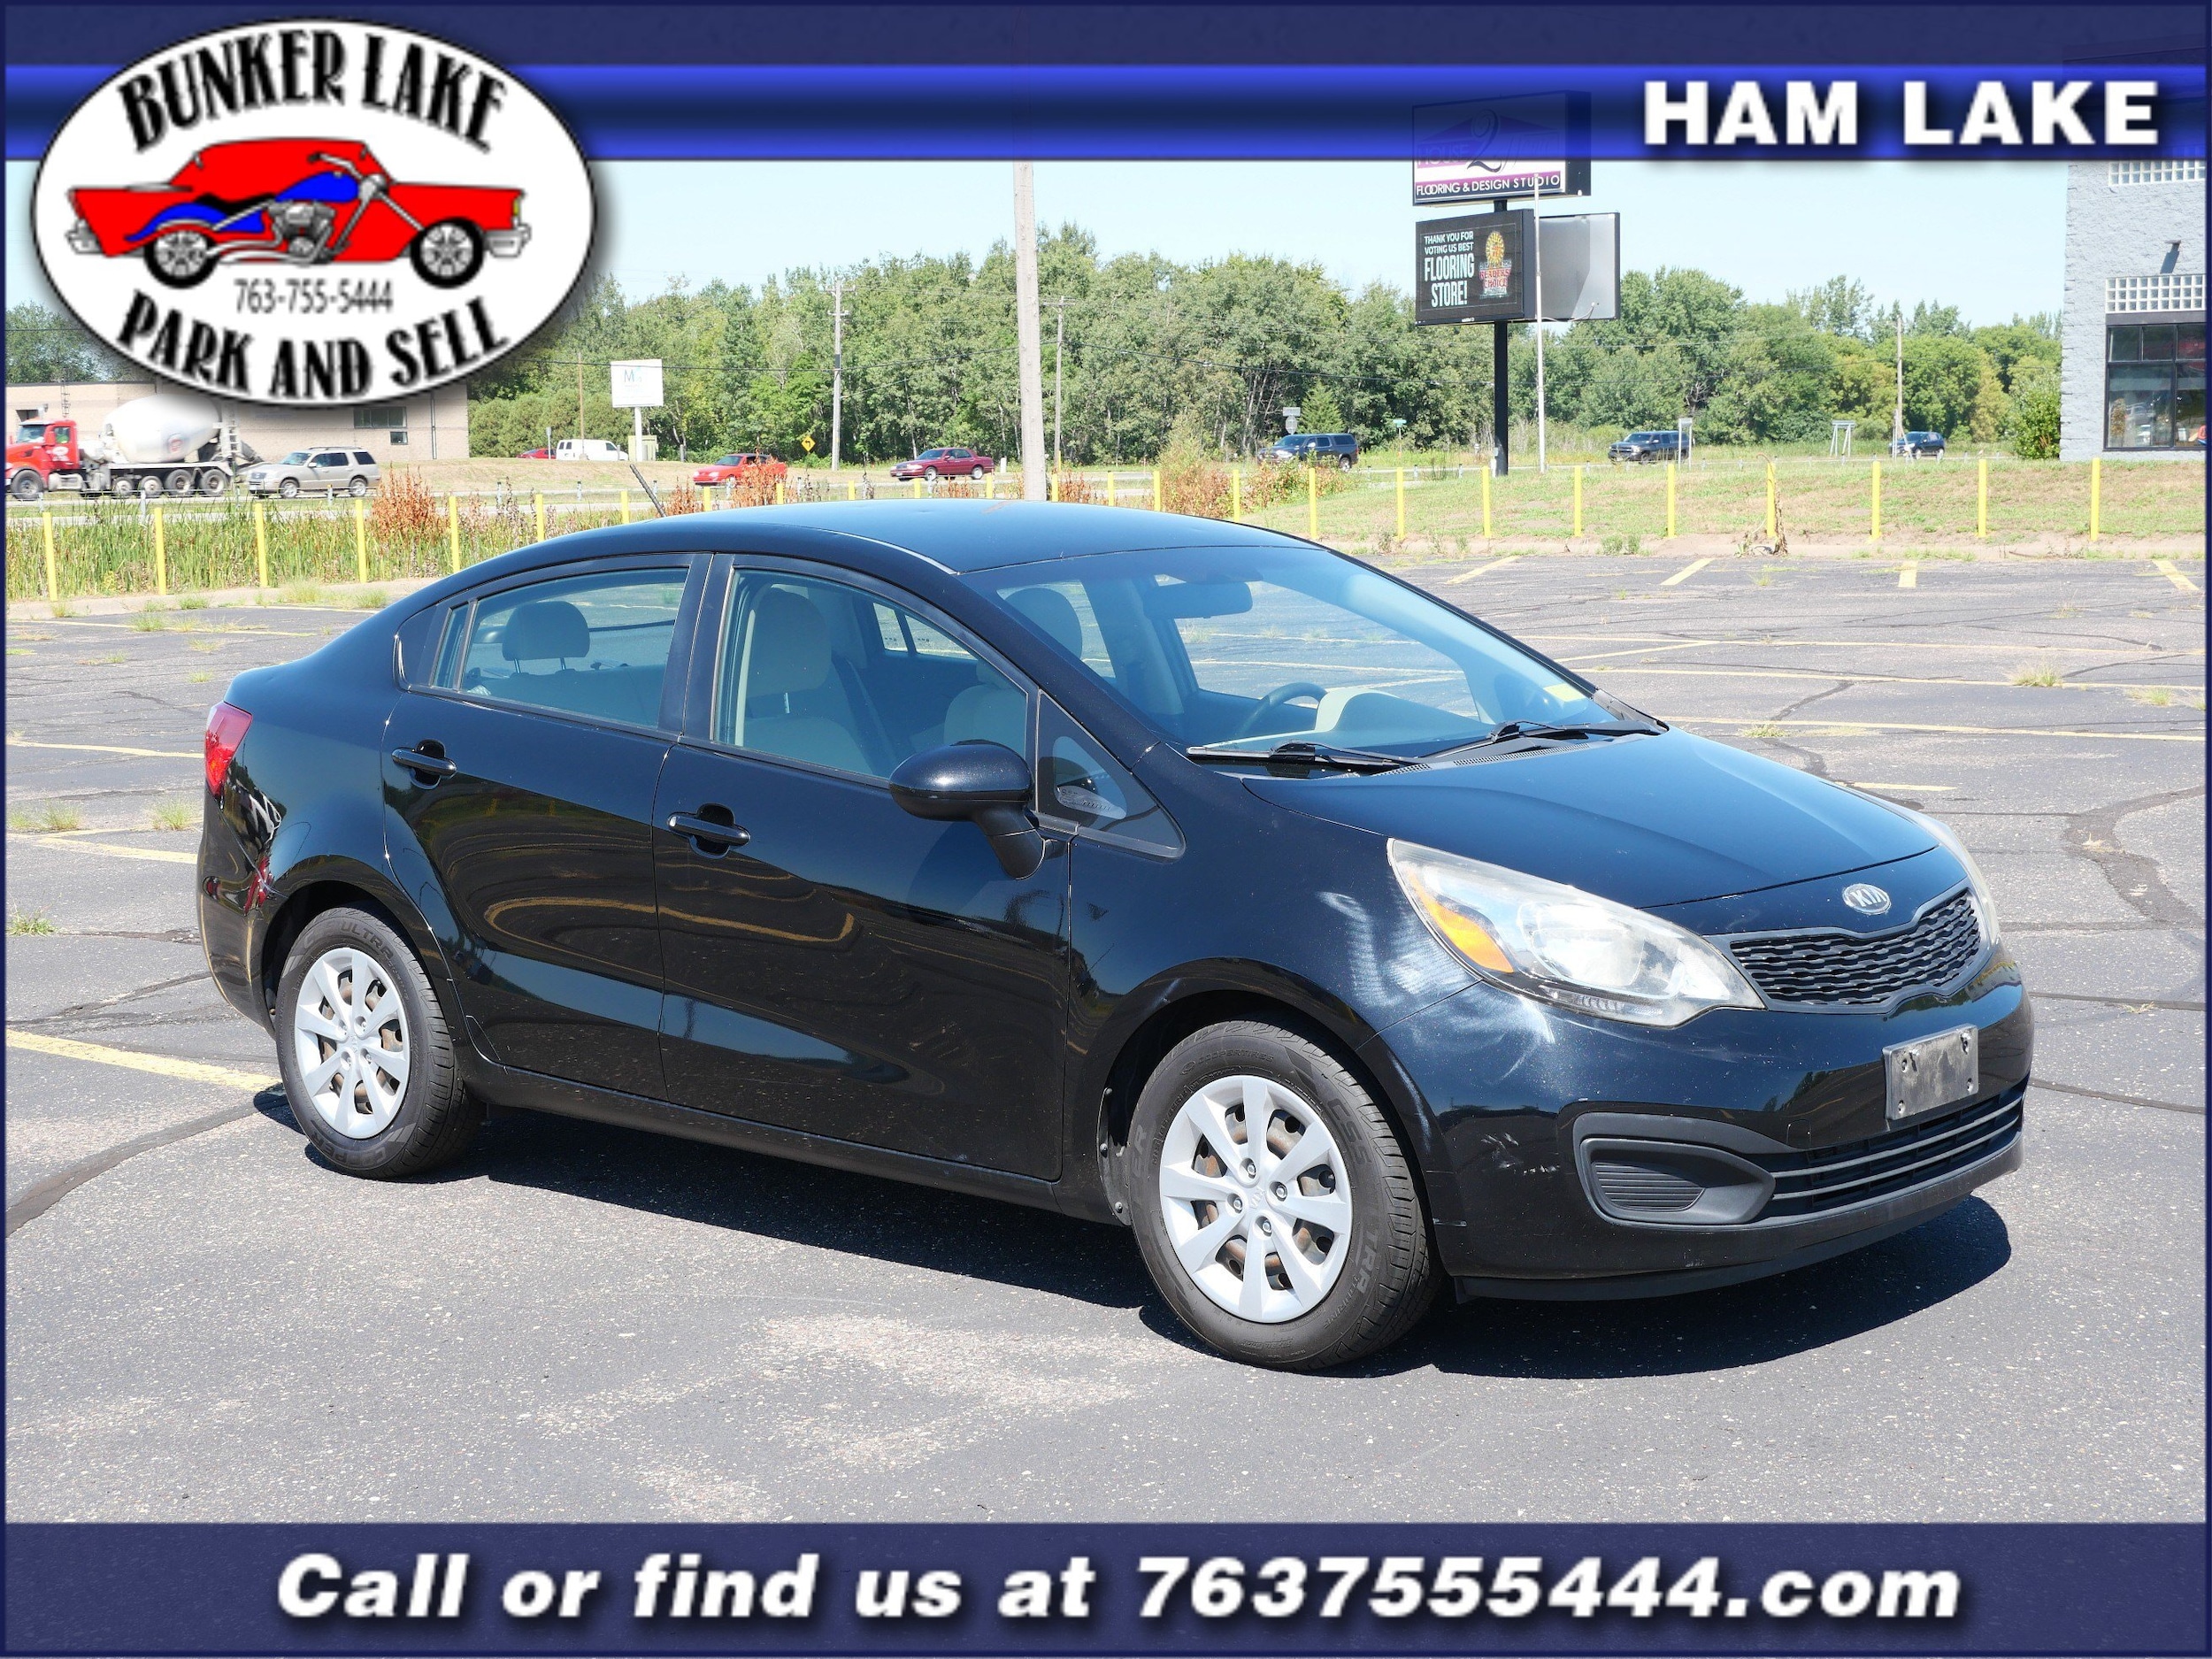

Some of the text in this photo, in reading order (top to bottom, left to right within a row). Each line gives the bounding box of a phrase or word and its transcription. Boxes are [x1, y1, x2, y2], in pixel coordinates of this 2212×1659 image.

[1417, 174, 1560, 196] FLOORING & DESIGN STUDIO
[1424, 230, 1474, 245] THANK YOU FOR
[1425, 242, 1474, 255] VOTING US BEST
[1424, 253, 1475, 281] FLOORING
[1431, 280, 1468, 308] STORE!
[1848, 887, 1887, 908] KIA
